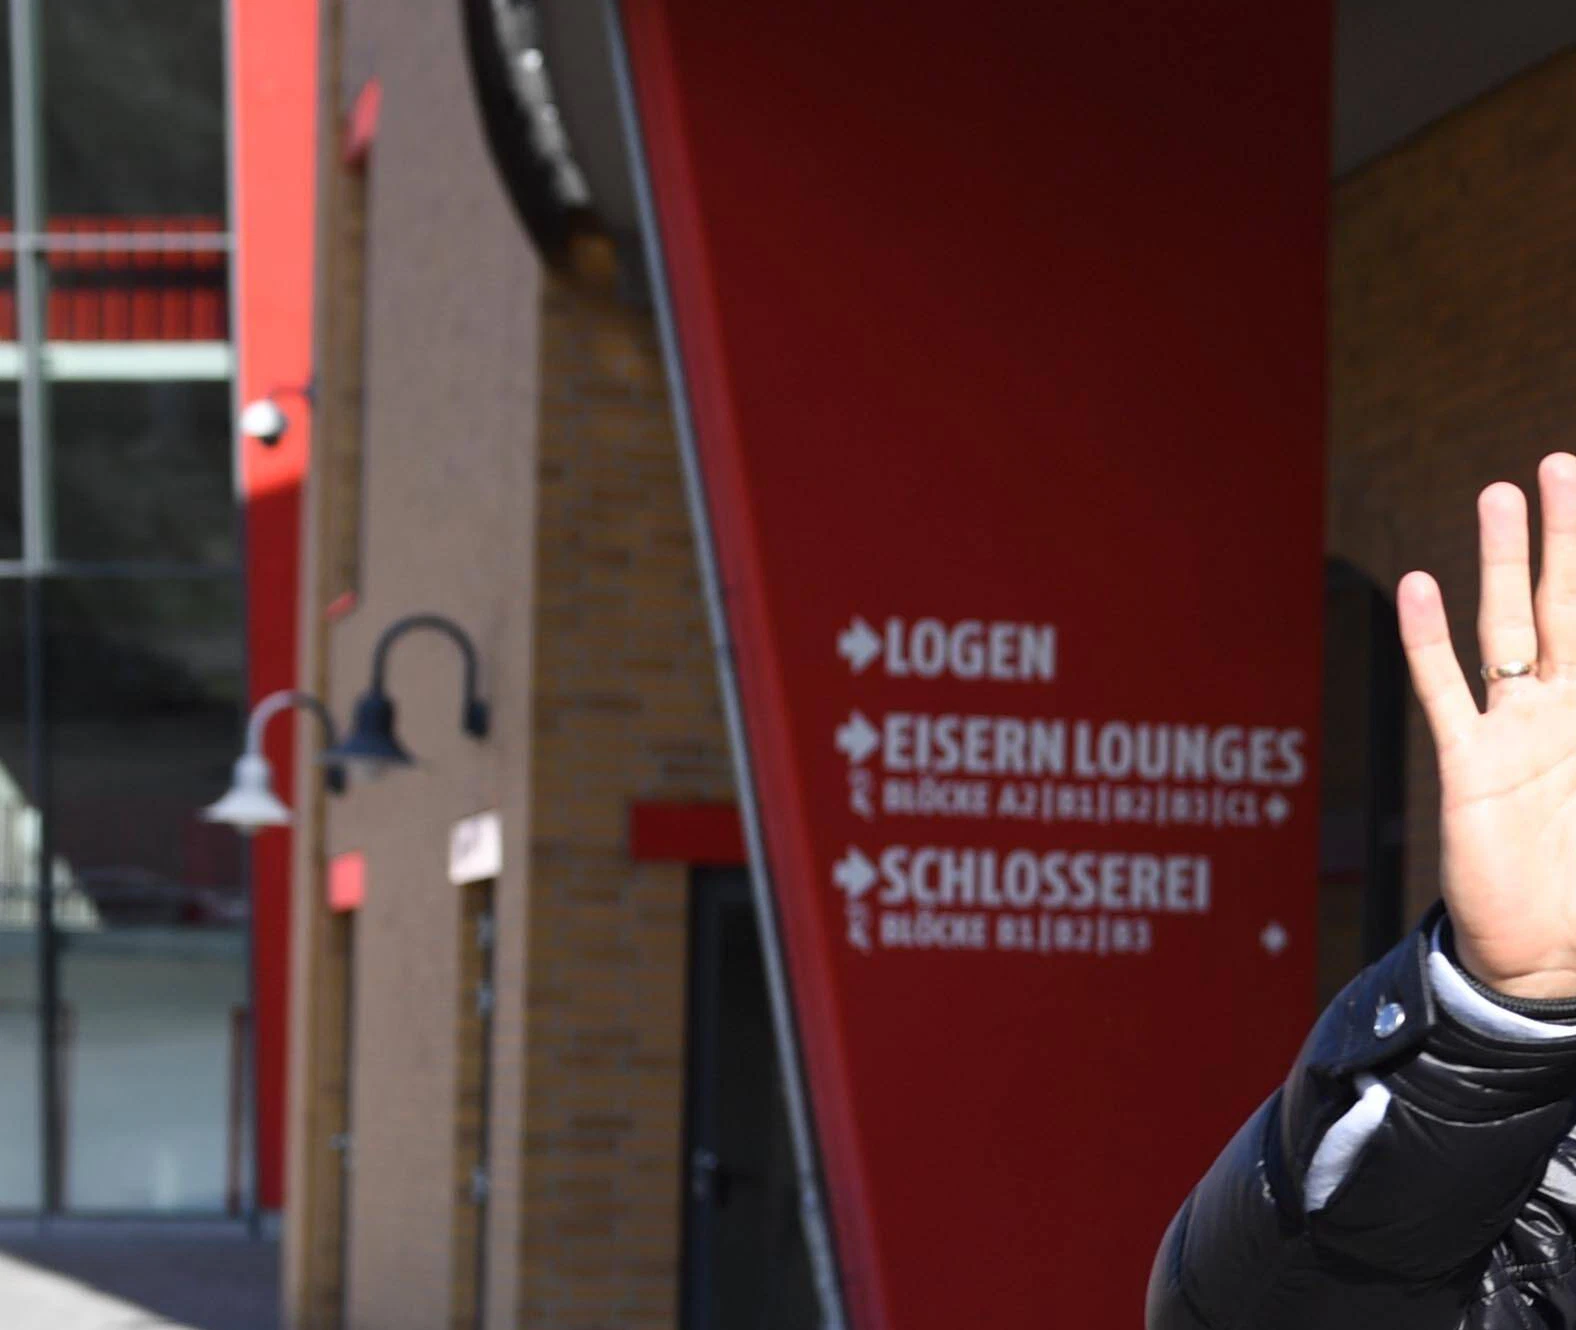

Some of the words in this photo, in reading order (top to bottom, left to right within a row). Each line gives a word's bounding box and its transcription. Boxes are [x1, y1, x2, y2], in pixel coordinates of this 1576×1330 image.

[885, 617, 1056, 681] LOGEN
[883, 712, 1064, 776] EISERN
[1074, 719, 1305, 786] LOUNGES
[879, 845, 1211, 914] SCHLOSSEREI
